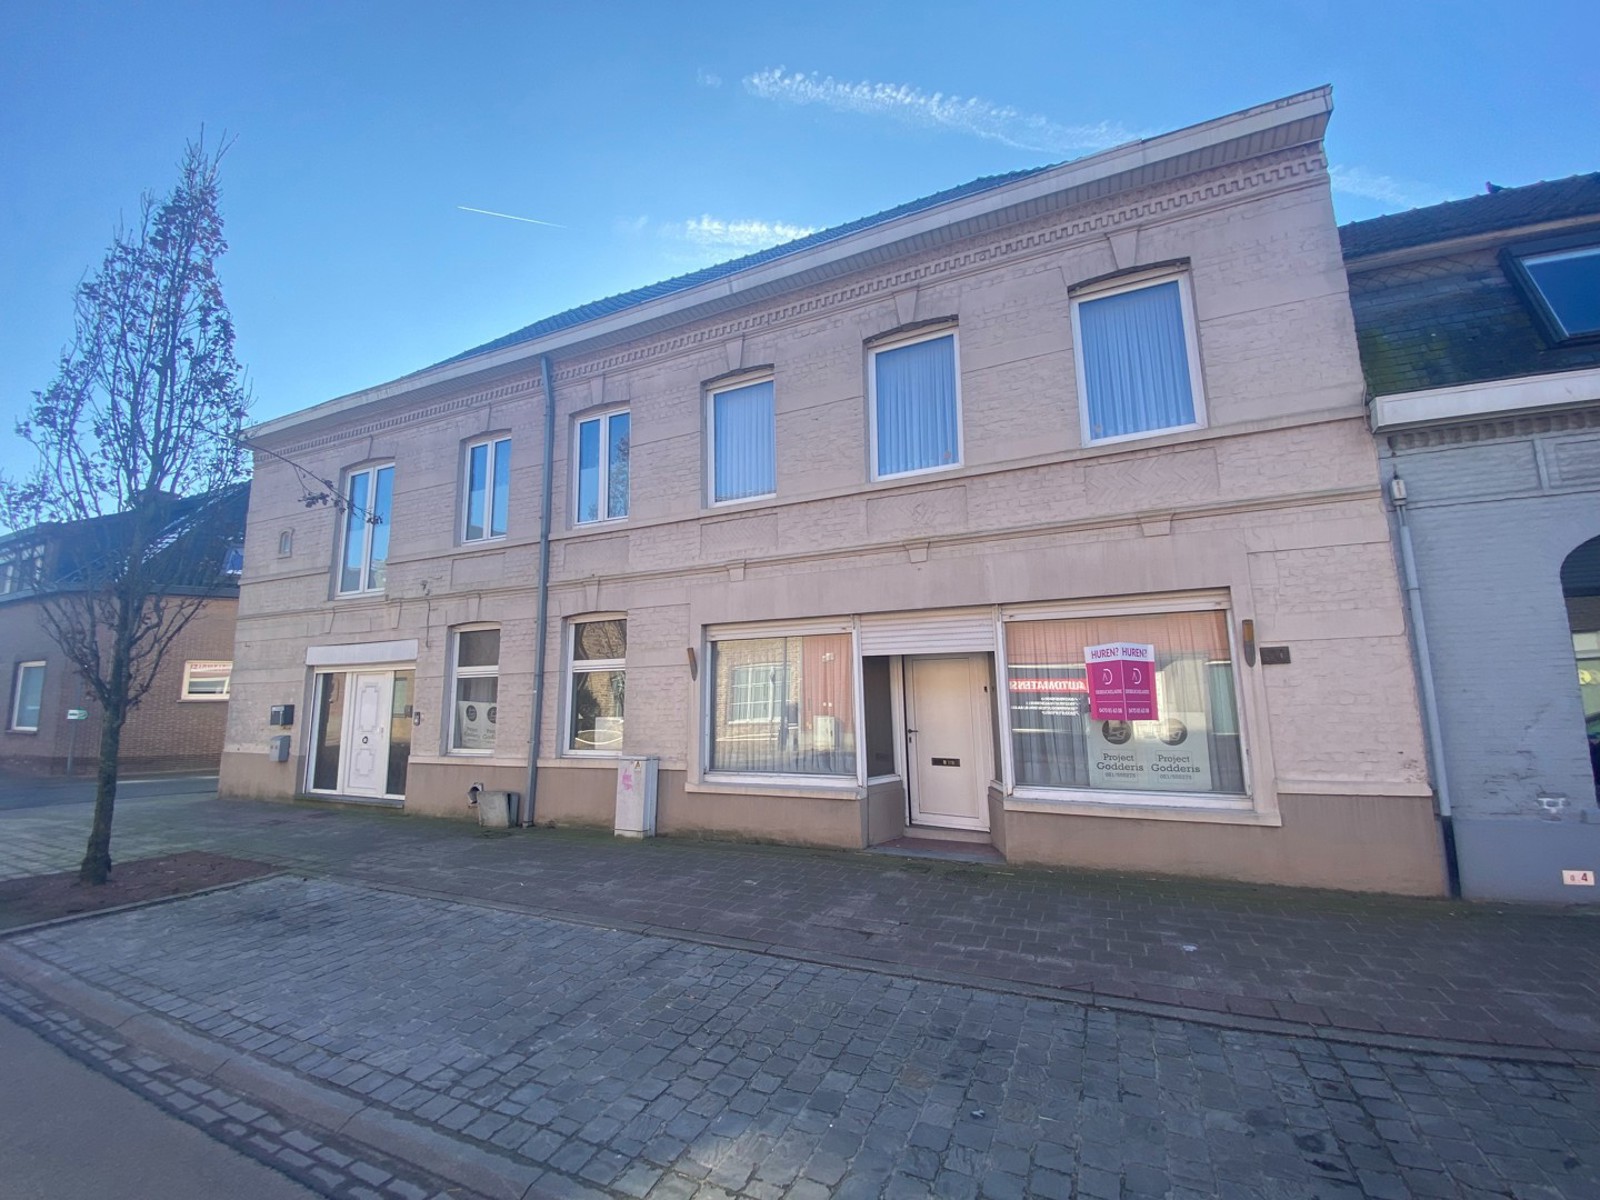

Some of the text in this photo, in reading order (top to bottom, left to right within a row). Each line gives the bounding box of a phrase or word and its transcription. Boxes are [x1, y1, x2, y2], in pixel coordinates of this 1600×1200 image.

[1091, 647, 1119, 659] HUREN?
[1121, 647, 1148, 658] HUREN?
[1103, 753, 1134, 762] Project
[1158, 754, 1190, 764] Project
[1096, 762, 1144, 771] Godderis
[1151, 764, 1200, 773] Godderis
